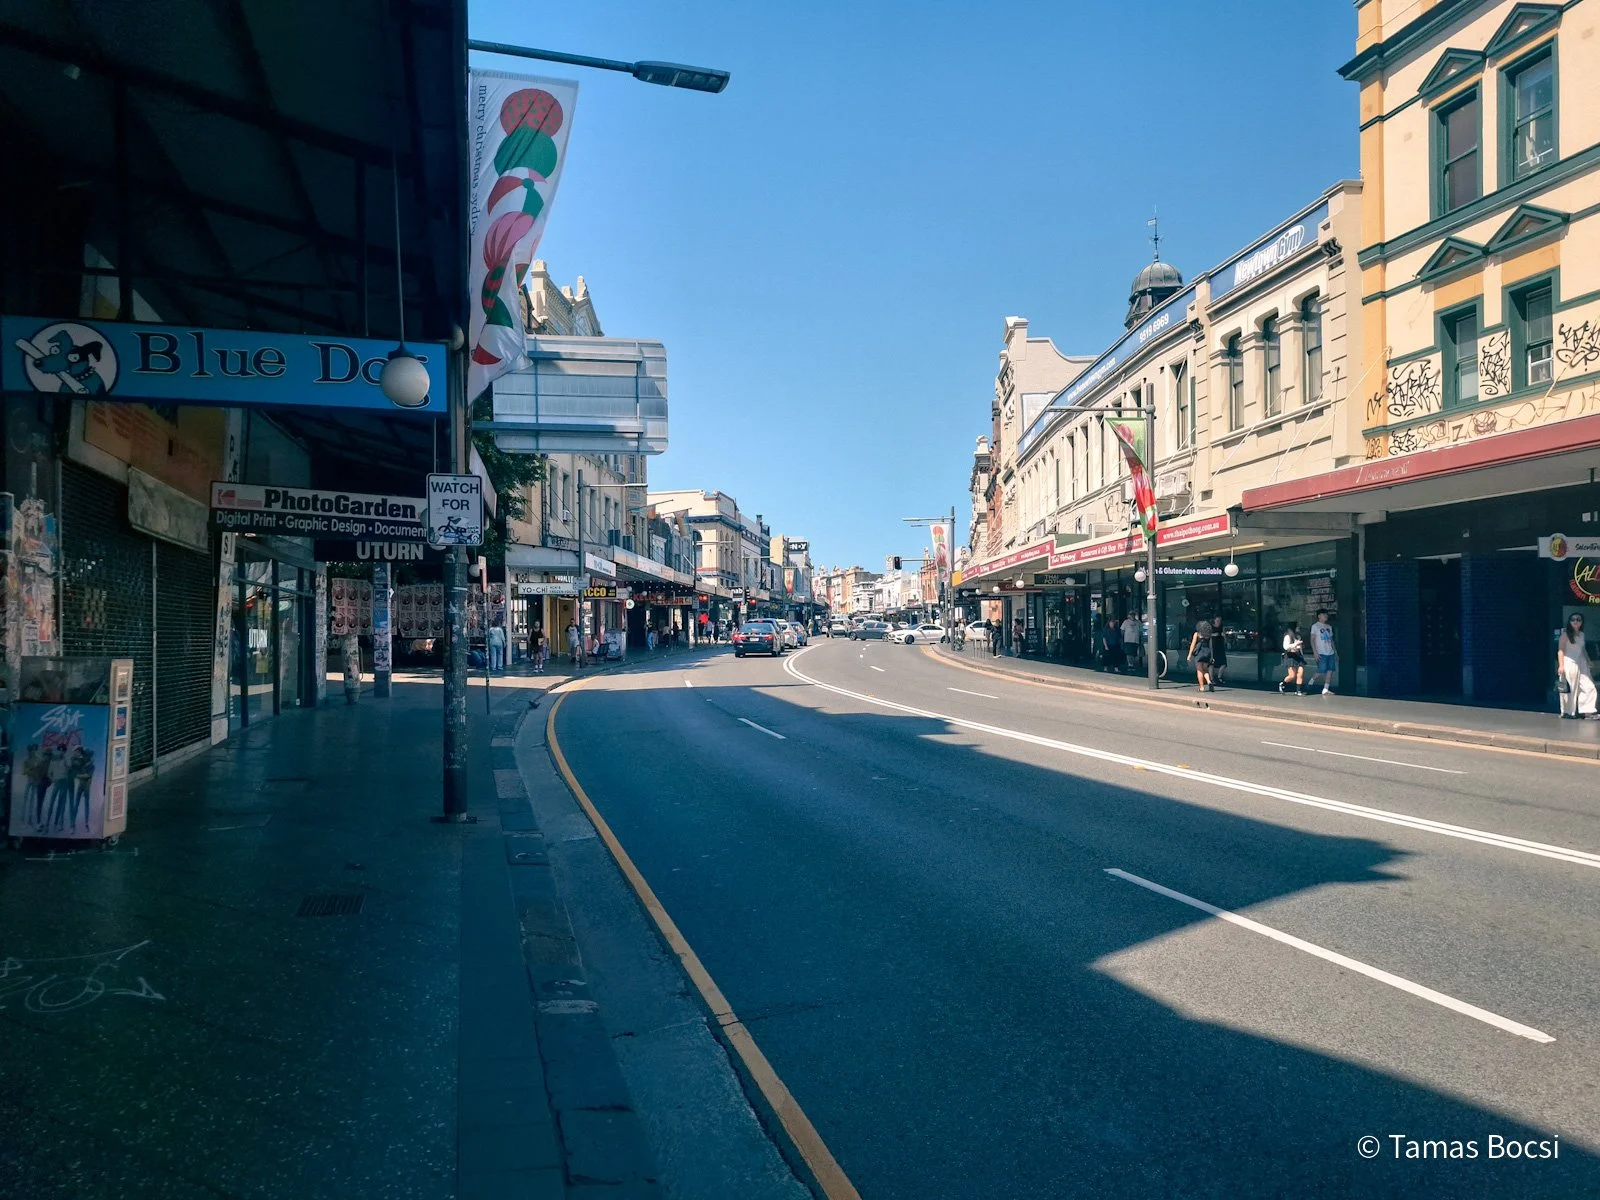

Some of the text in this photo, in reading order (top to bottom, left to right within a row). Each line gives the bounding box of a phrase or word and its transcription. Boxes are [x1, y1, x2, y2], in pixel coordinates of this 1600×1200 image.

[478, 85, 487, 121] merry
[130, 331, 432, 409] Blue Do
[431, 482, 479, 494] WATCH
[264, 488, 417, 519] PhotoGarden
[442, 499, 470, 511] FOR
[216, 510, 251, 528] Digital
[253, 513, 277, 528] Print
[285, 515, 329, 533] Graphic
[331, 518, 367, 536] Design
[356, 541, 425, 561] UTURN
[1163, 567, 1196, 575] Gluten-free
[1196, 567, 1222, 575] available
